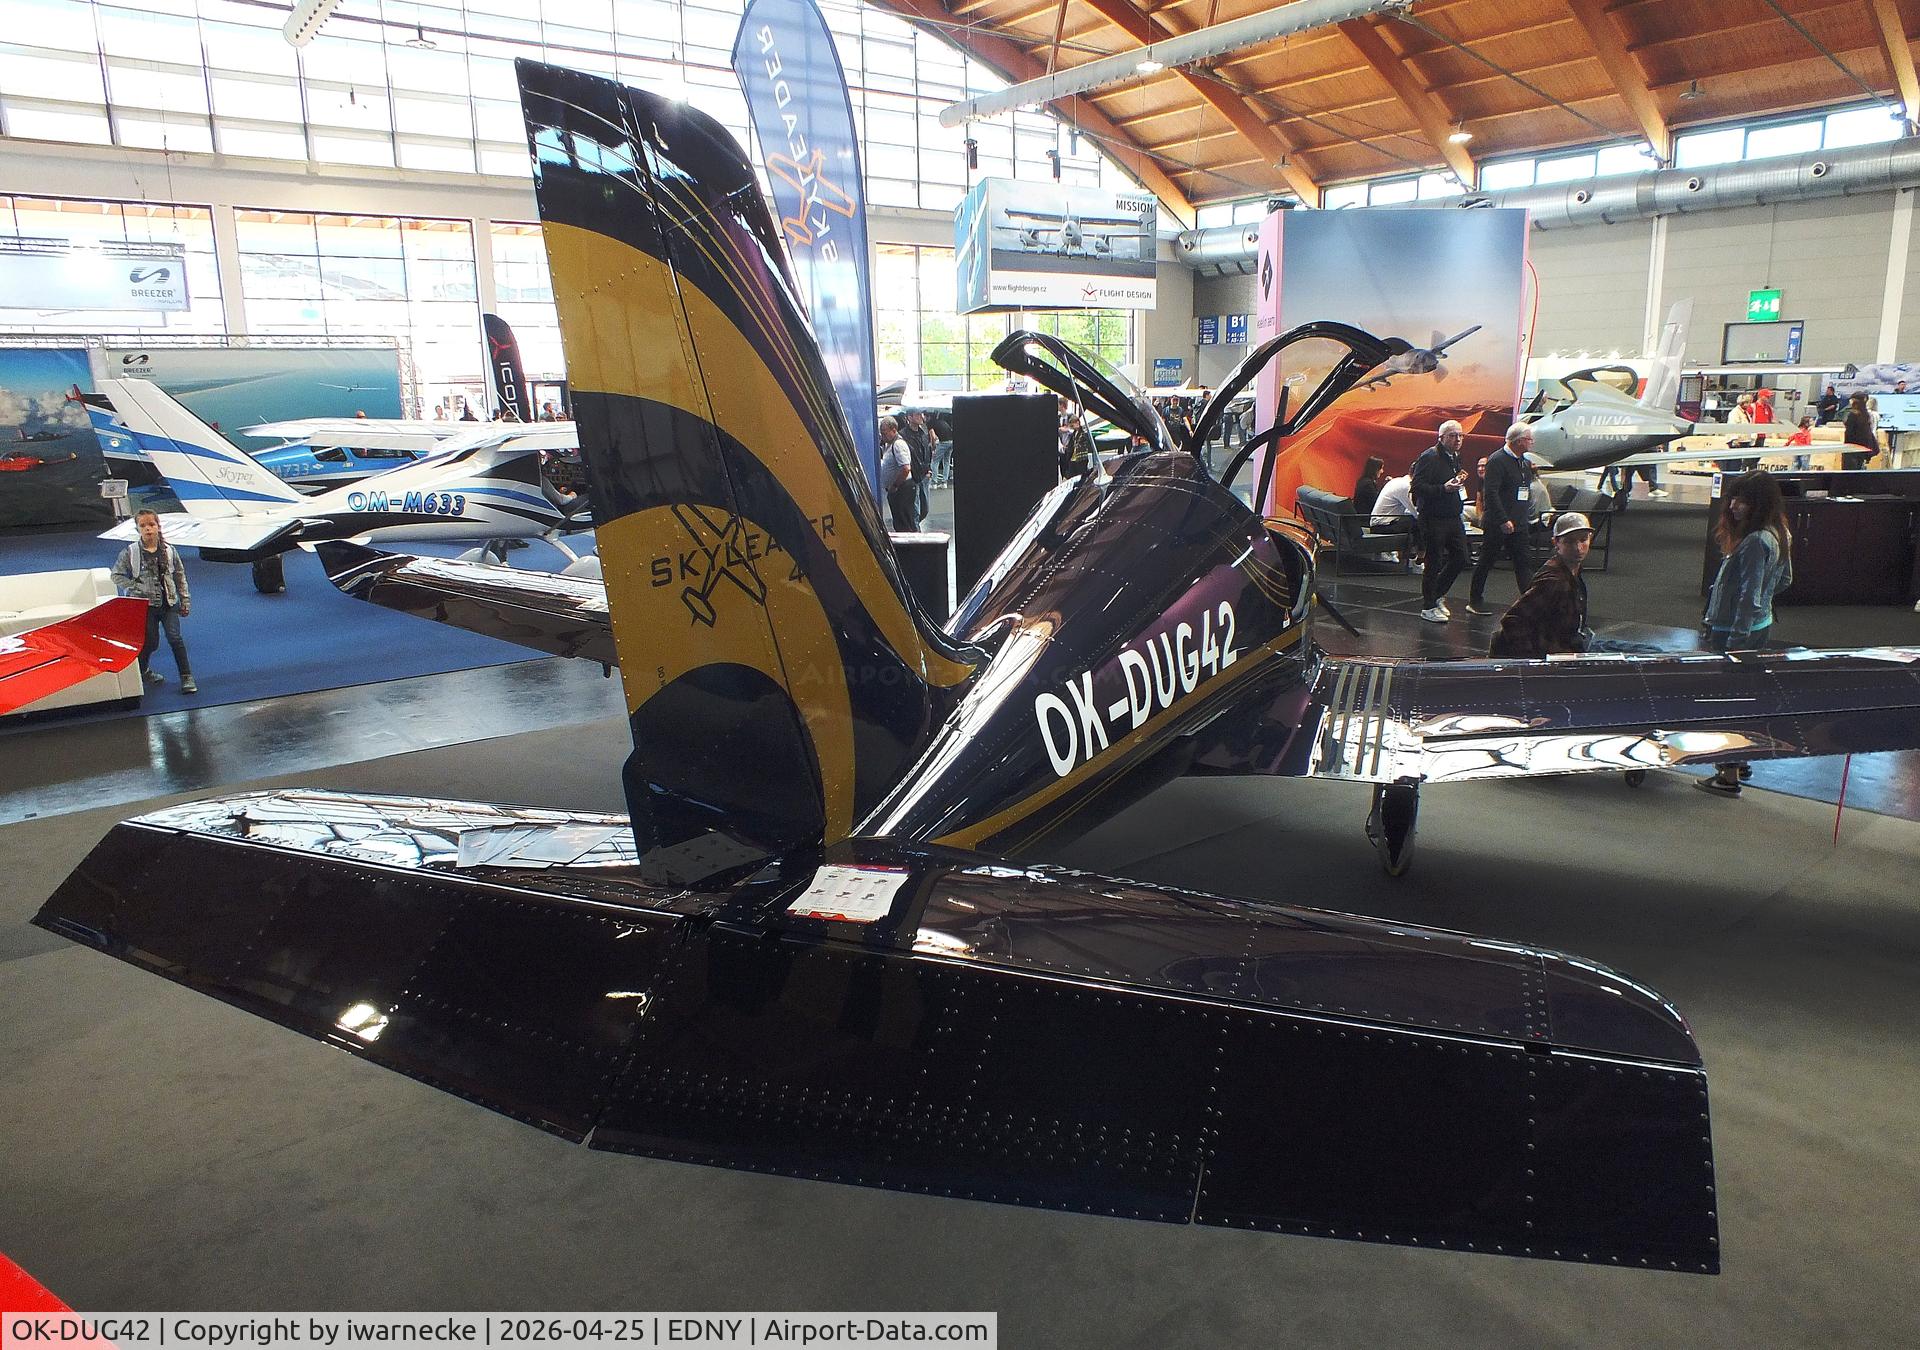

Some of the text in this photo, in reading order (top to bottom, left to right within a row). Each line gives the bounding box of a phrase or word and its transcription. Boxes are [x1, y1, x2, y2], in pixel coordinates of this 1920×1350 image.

[1116, 200, 1153, 213] MISSION
[131, 289, 174, 298] BREEZER
[992, 284, 1047, 294] www.flightdesign.cz
[1100, 290, 1152, 299] FLIGHT DESIGN
[1231, 316, 1245, 328] B1
[347, 490, 467, 517] OM-M633
[651, 513, 836, 588] SKYLEAR
[1034, 600, 1238, 777] OK-DUG42
